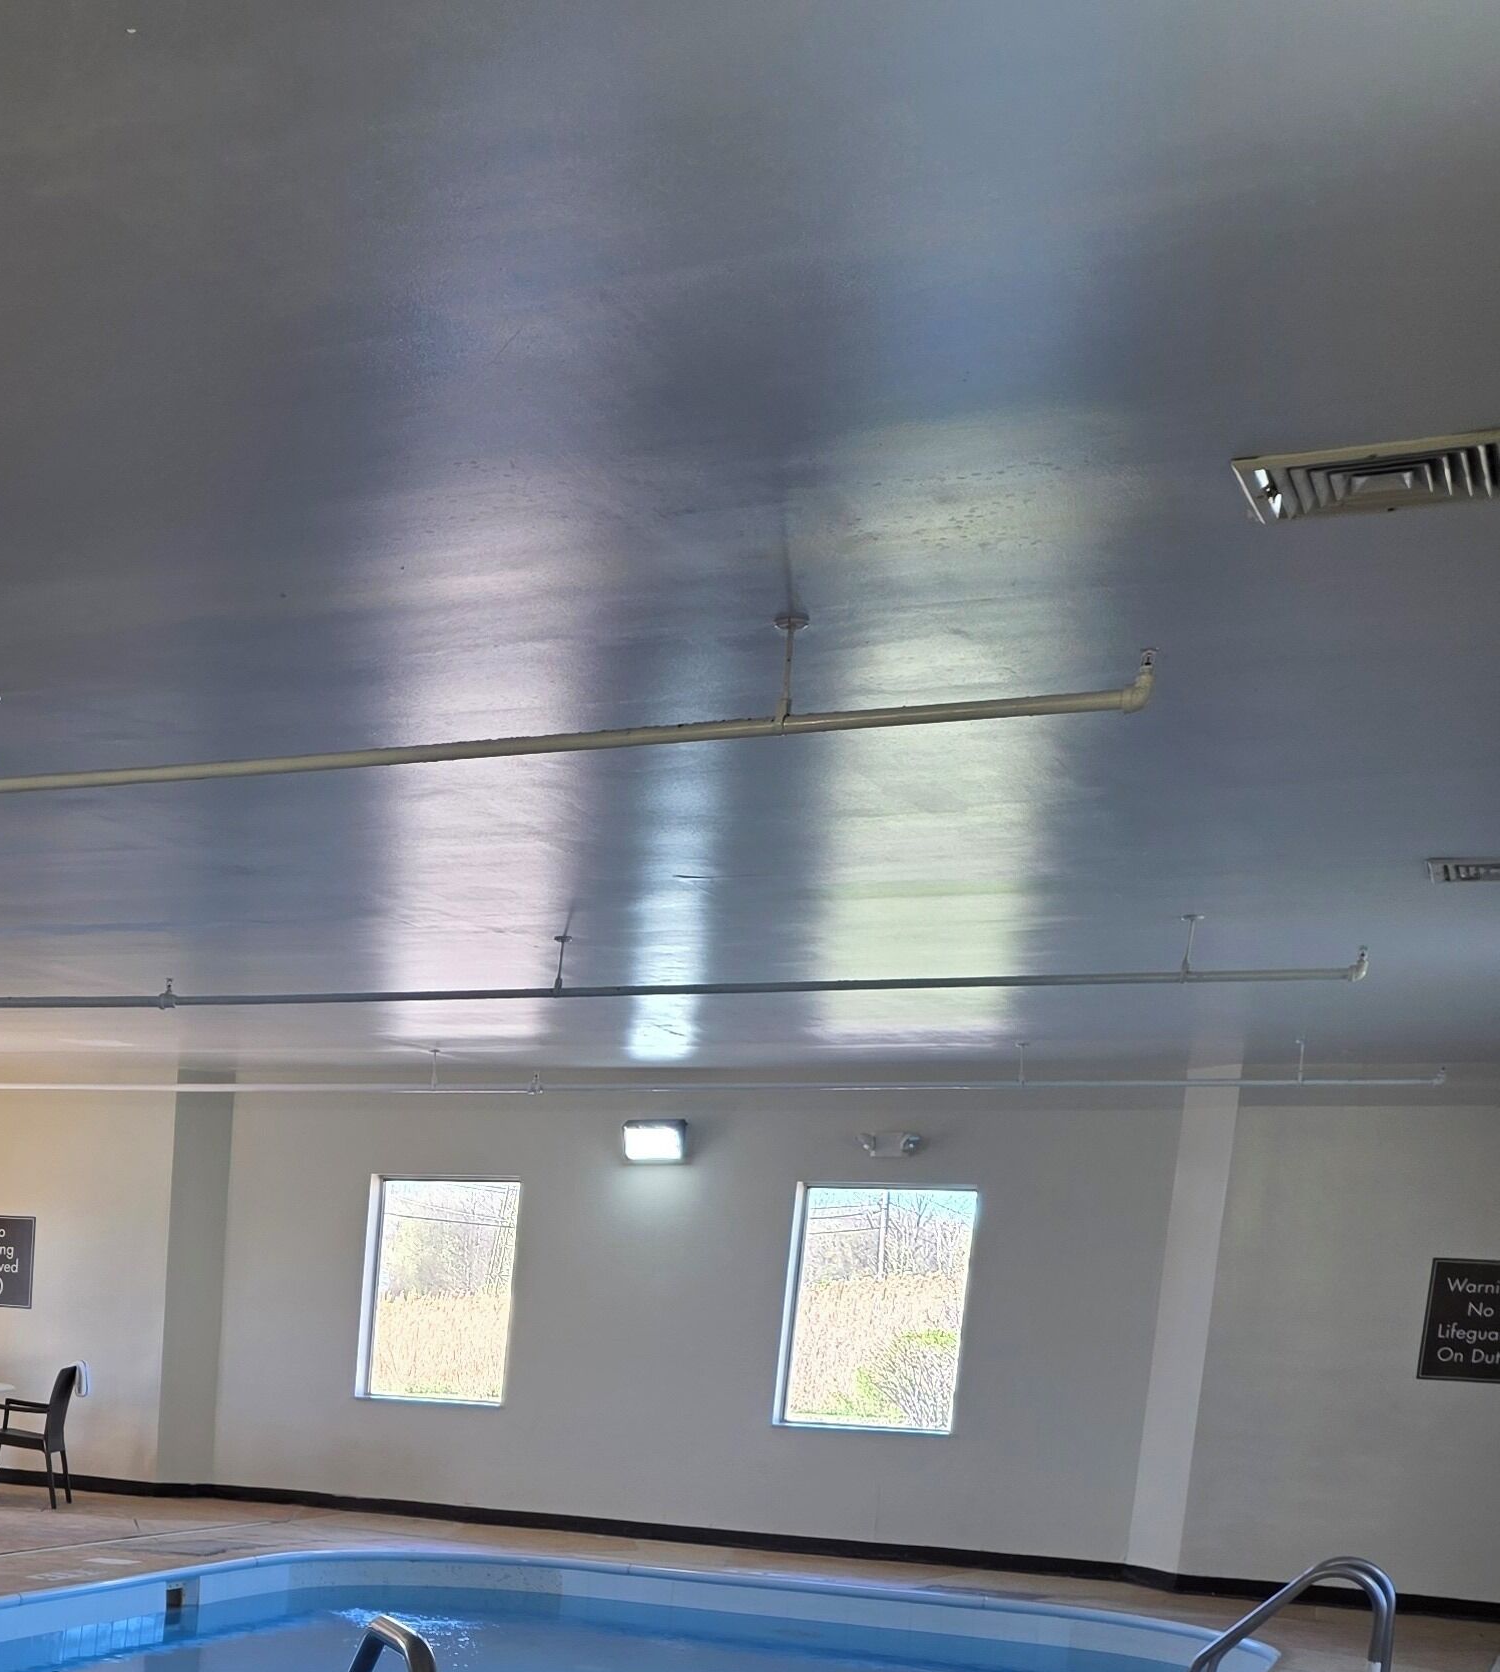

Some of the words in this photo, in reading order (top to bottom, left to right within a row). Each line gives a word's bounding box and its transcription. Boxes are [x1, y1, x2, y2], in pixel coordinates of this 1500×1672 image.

[1447, 1277, 1500, 1295] Warni
[1467, 1301, 1495, 1318] No
[1437, 1322, 1500, 1345] Lifegua
[1437, 1346, 1464, 1363] On
[1471, 1348, 1500, 1365] Dut
